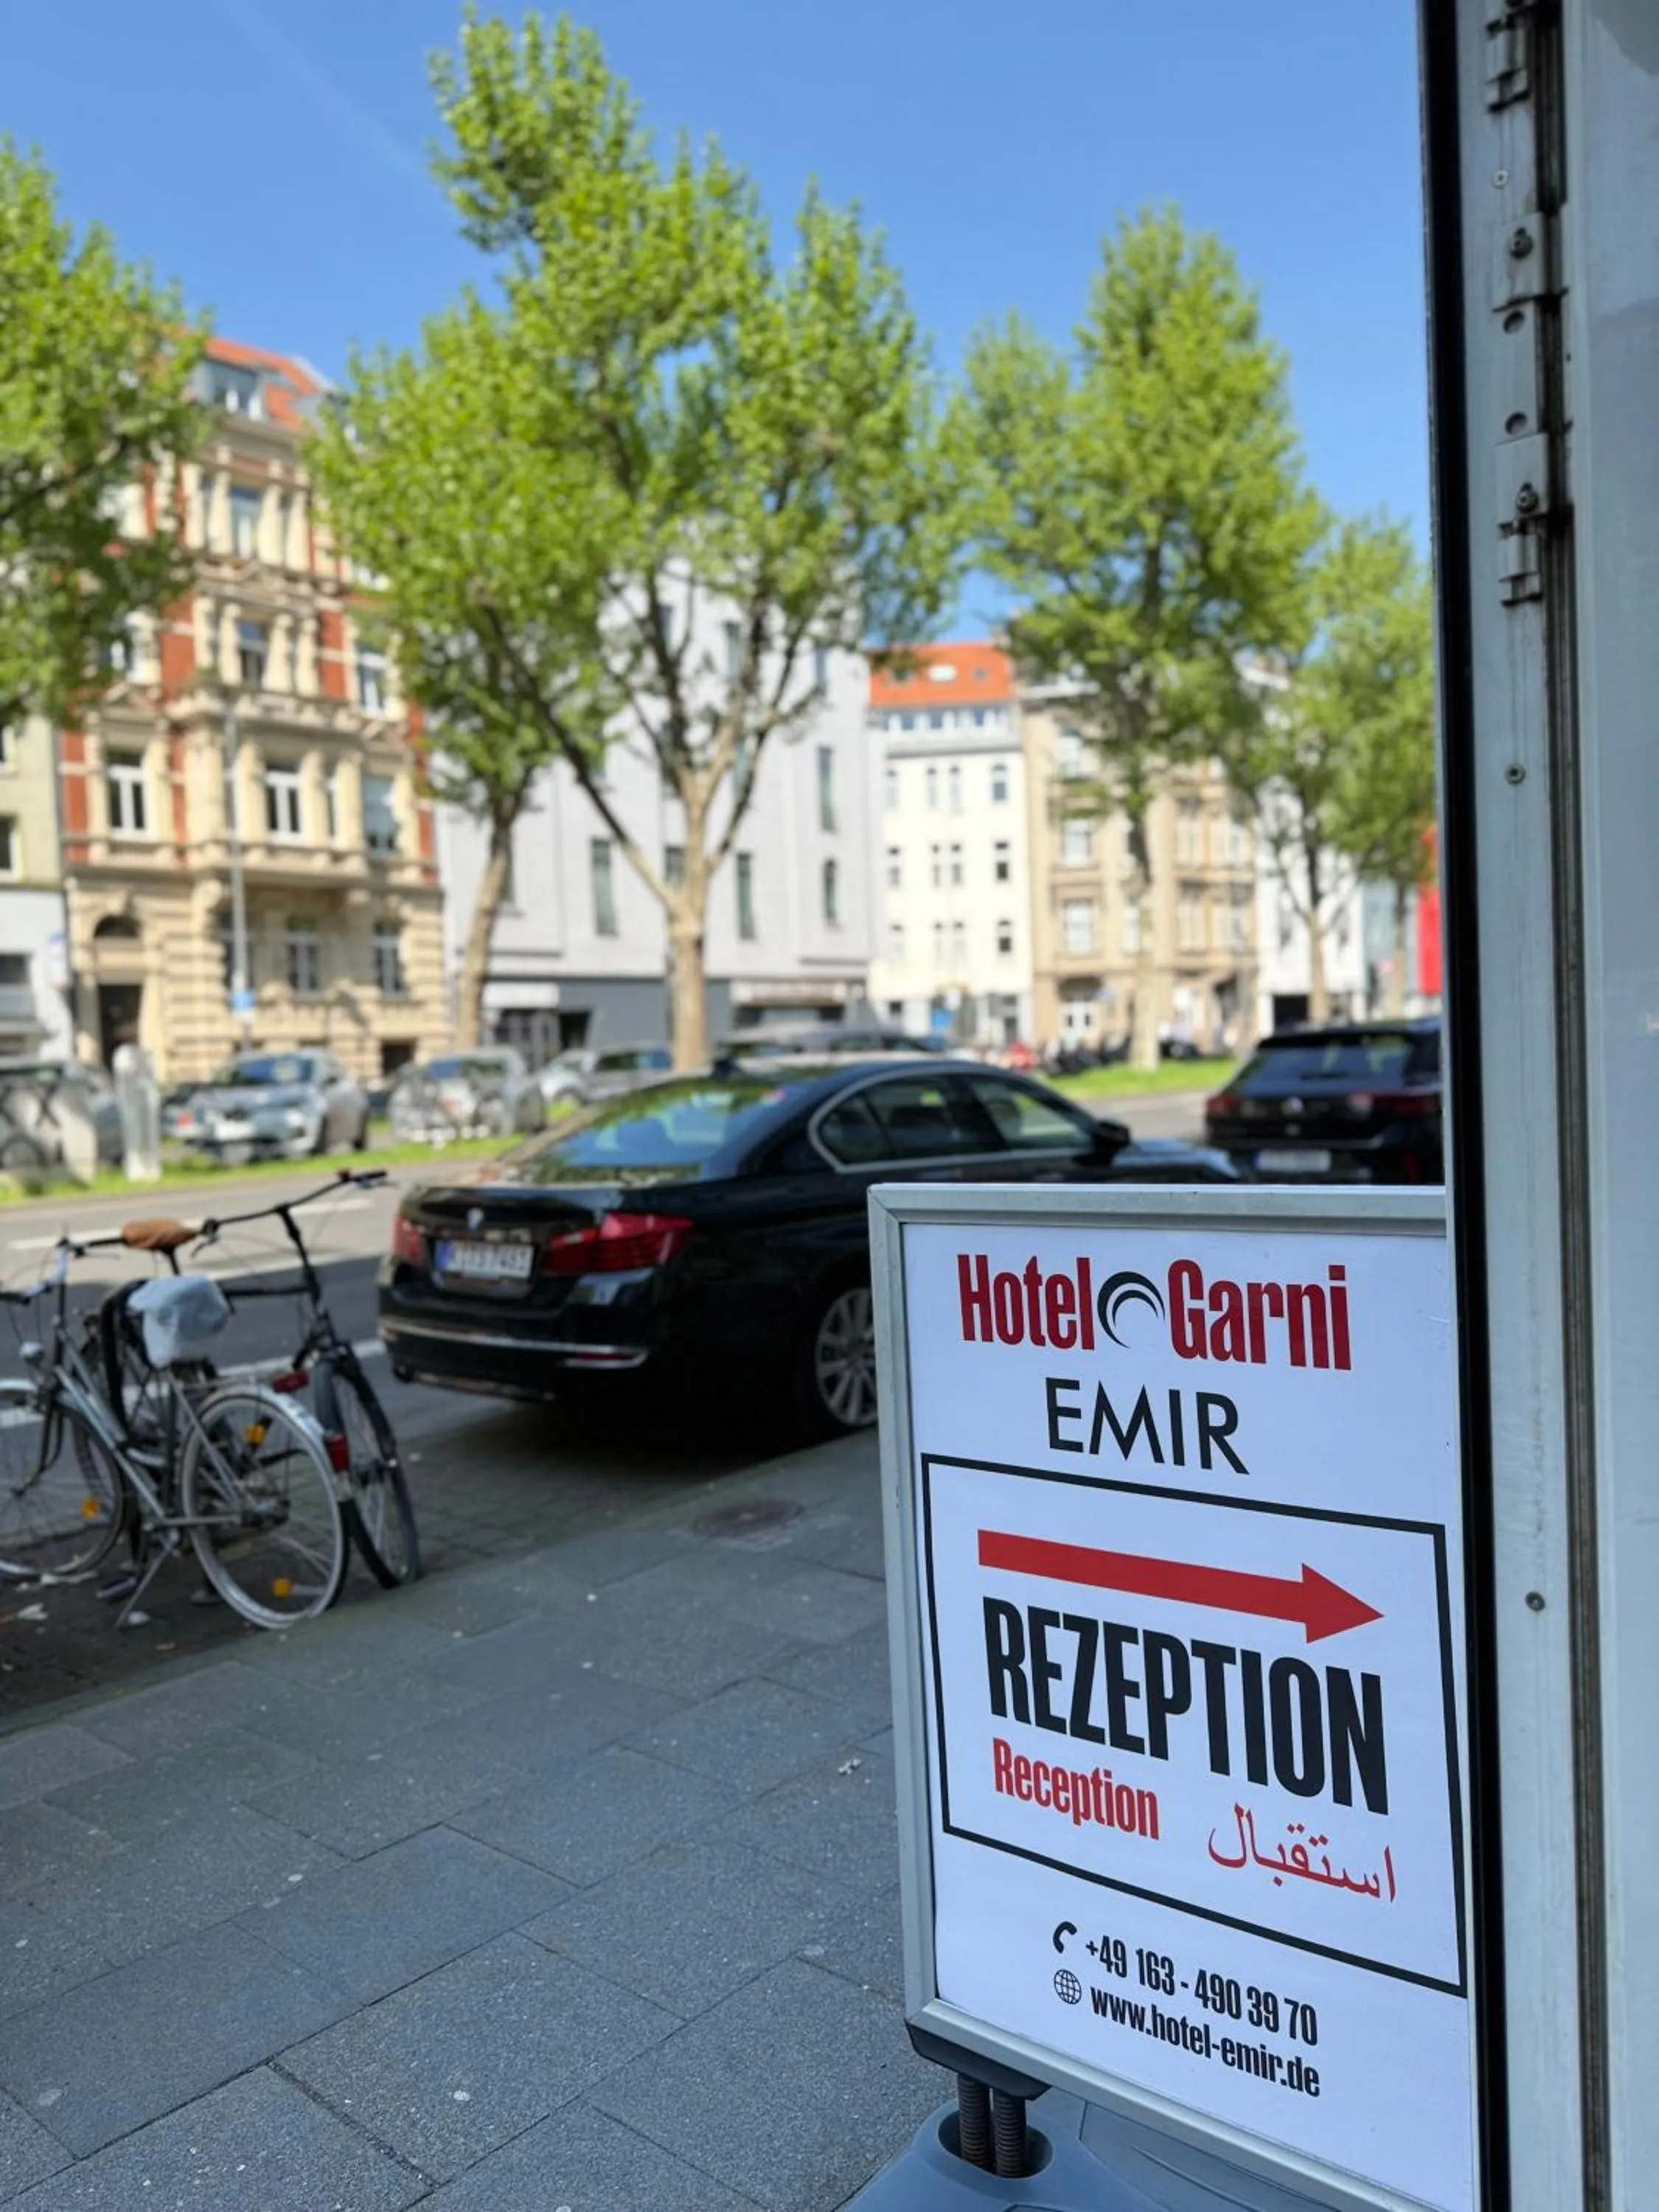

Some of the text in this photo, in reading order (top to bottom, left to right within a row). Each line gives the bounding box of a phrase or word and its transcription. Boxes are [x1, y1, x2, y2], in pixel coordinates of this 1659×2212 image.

[956, 1253, 1352, 1371] Hotel Garni
[1045, 1377, 1251, 1475] EMIR
[982, 1596, 1389, 1816] REZEPTION
[992, 1738, 1159, 1841] Reception
[1208, 1802, 1396, 1903] استقبال
[1085, 1935, 1127, 1978] +49
[1135, 1947, 1175, 1997] 163
[1194, 1968, 1242, 2020] 490
[1246, 1985, 1280, 2034] 39
[1284, 1997, 1318, 2046] 70
[1090, 1986, 1321, 2098] www.hotel-emir.de
